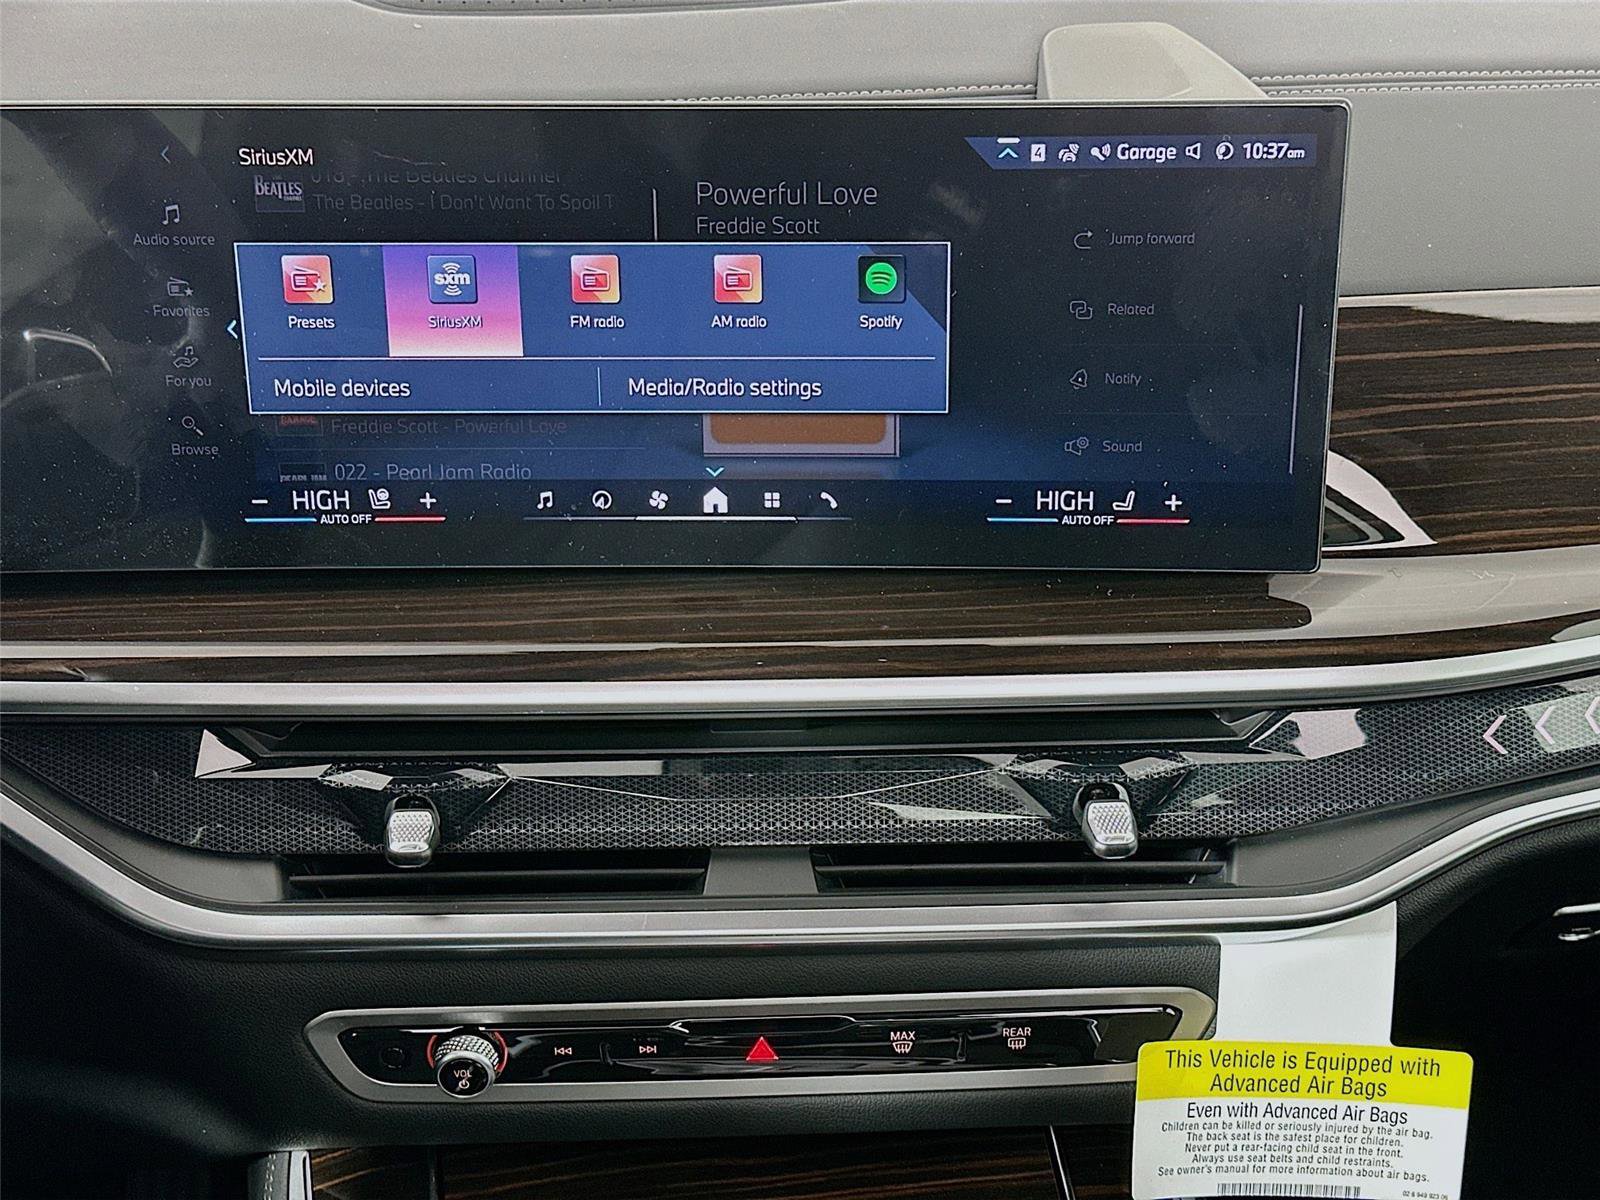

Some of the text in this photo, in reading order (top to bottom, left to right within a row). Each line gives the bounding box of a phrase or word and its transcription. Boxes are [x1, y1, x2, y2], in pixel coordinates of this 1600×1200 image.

[238, 147, 314, 166] SiriusXM
[1117, 143, 1176, 163] Garage
[1242, 142, 1306, 160] 10:37am
[255, 175, 303, 199] BEATLES
[697, 181, 878, 206] Powerful Love
[312, 194, 344, 209] The
[350, 194, 413, 210] Beatles
[441, 194, 484, 210] Don't
[488, 194, 532, 210] Want
[535, 194, 555, 210] To
[559, 194, 600, 212] Spoil
[696, 216, 820, 235] Freddie Scott
[133, 233, 215, 246] Audio source
[1108, 231, 1195, 247] Jump forward
[434, 273, 471, 285] sxm
[153, 304, 211, 317] Favorites
[1107, 303, 1155, 316] Related
[288, 315, 335, 329] Presets
[428, 315, 482, 328] SiriusXM
[570, 315, 625, 329] FM radio
[711, 315, 767, 329] AM radio
[859, 315, 904, 331] Spotify
[166, 374, 212, 389] For you
[274, 378, 411, 397] Mobile devices
[1105, 372, 1142, 387] Notify
[628, 377, 823, 400] Media/Radio settings
[331, 418, 393, 434] Freddie
[397, 418, 439, 434] Scott
[455, 418, 524, 434] Powerful
[529, 418, 568, 433] Love
[171, 443, 219, 456] Browse
[1102, 440, 1143, 453] Sound
[334, 463, 368, 480] 022
[387, 463, 432, 480] Pearl
[439, 463, 474, 480] Jam
[481, 463, 532, 480] Radio
[292, 490, 350, 510] HIGH
[1036, 490, 1094, 512] HIGH
[320, 514, 372, 525] AUTO OFF
[1062, 514, 1115, 526] AUTO OFF
[890, 1030, 916, 1041] MAX
[1003, 1026, 1031, 1037] REAR
[1166, 1049, 1441, 1077] This Vehicle is Equipped with
[453, 1069, 472, 1078] VOL
[1210, 1073, 1387, 1100] Advanced Air Bags
[1187, 1102, 1409, 1127] Even with Advanced Air Bags
[1162, 1121, 1433, 1140] Children can be killed or seriously injured by the air bag.
[1187, 1131, 1404, 1148] The back seat is the safest place for children.
[1185, 1143, 1404, 1158] Never put a rear-facing child seat in the front.
[1192, 1153, 1393, 1168] Always use seat belts and child restraints.
[1158, 1164, 1430, 1183] See owner's manual for more information about air bags.
